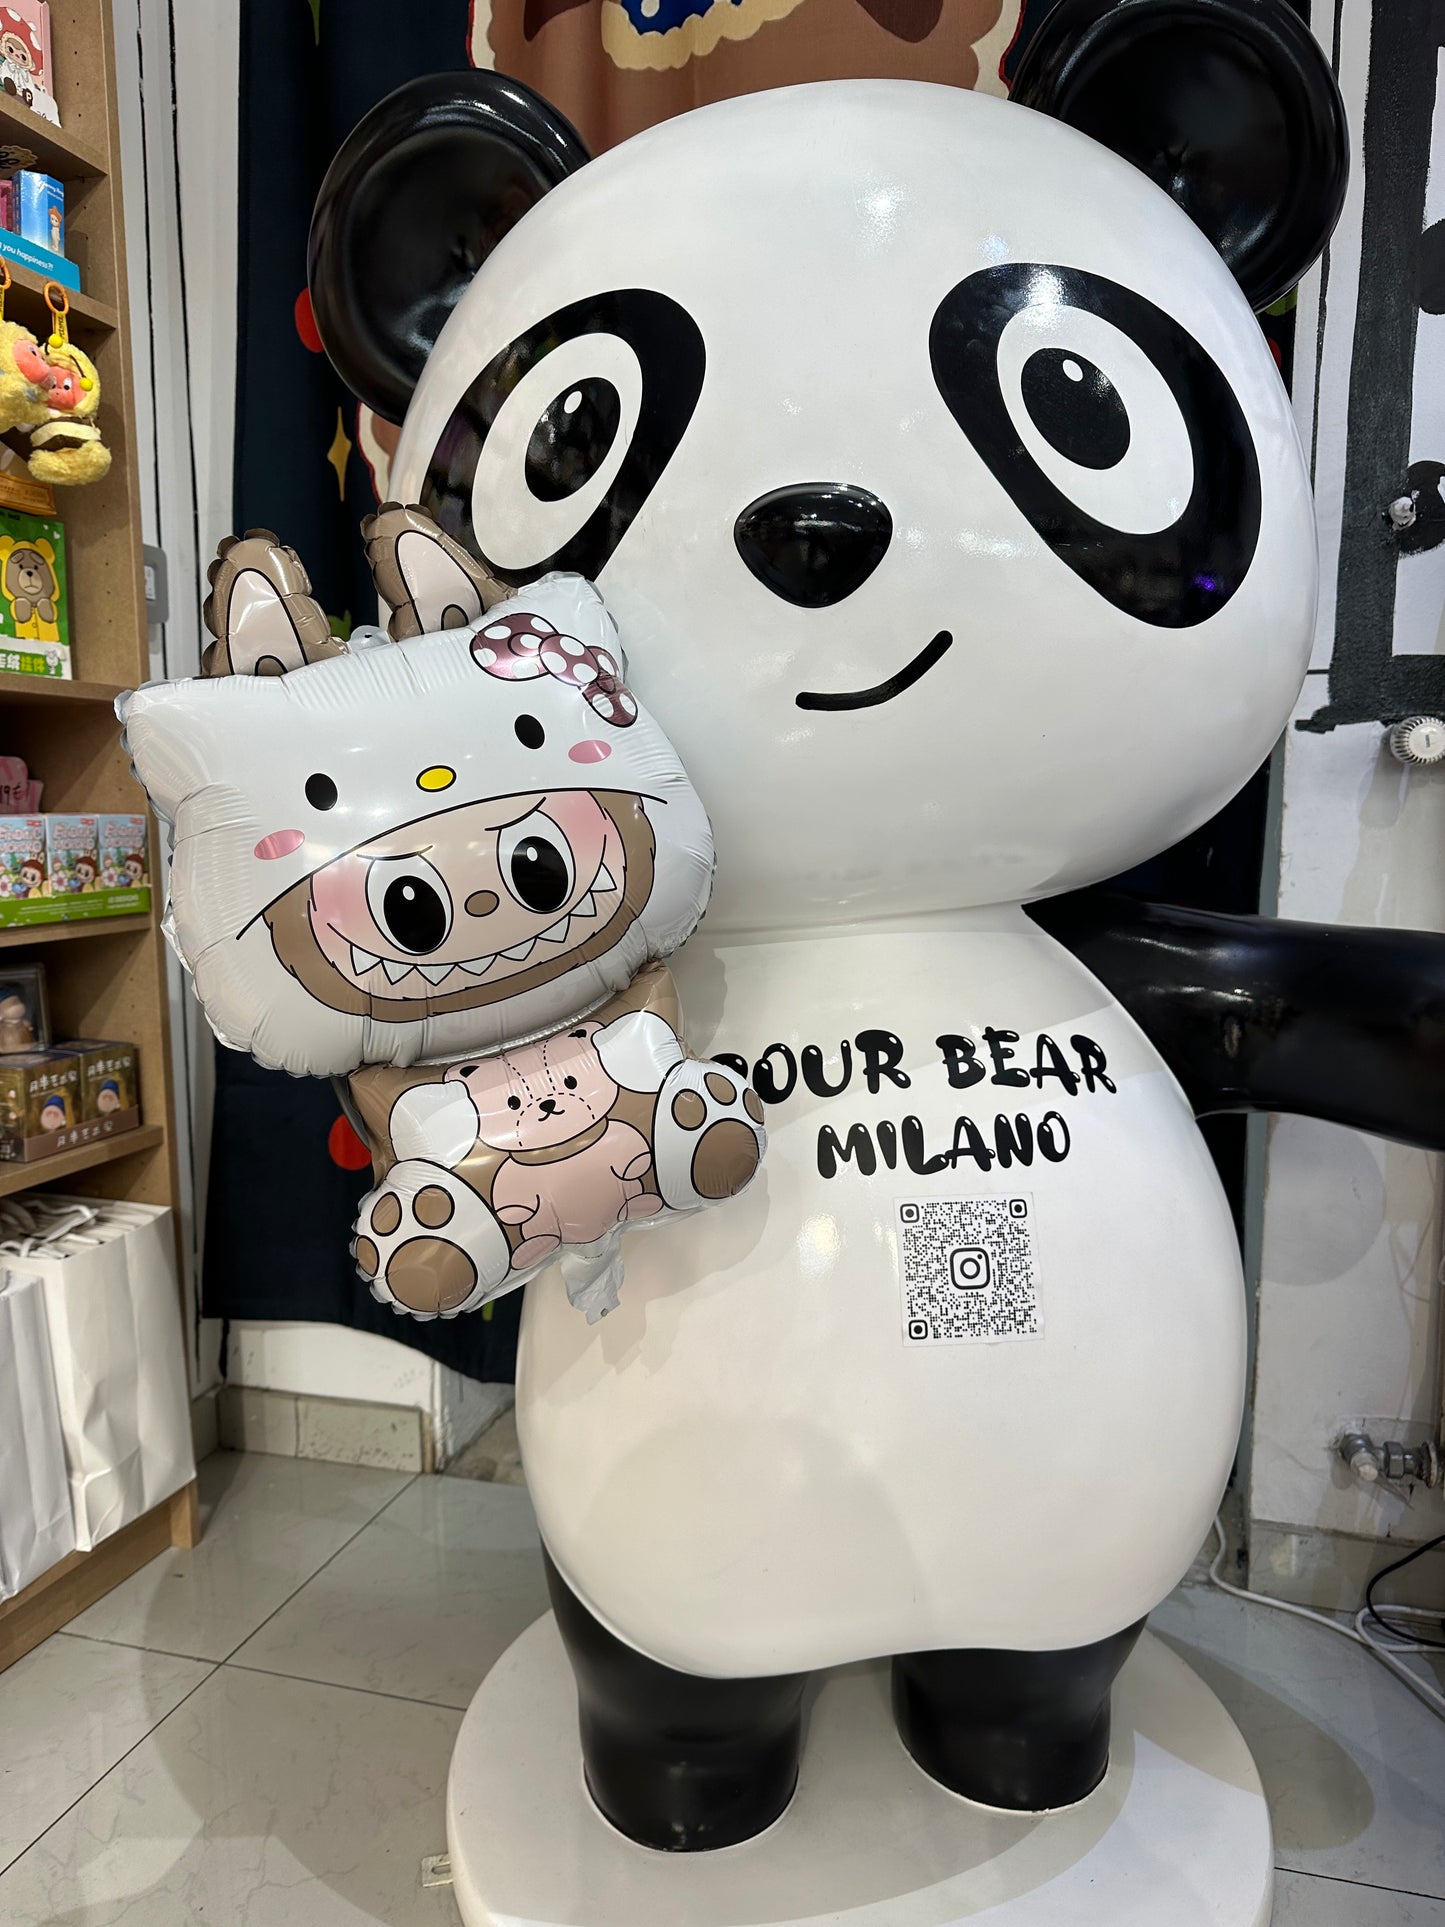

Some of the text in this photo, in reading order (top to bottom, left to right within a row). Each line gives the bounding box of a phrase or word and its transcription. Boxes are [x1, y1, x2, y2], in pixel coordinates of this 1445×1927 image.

[3, 243, 17, 254] you
[935, 1026, 1118, 1096] BEAR
[817, 1110, 1071, 1179] MILANO
